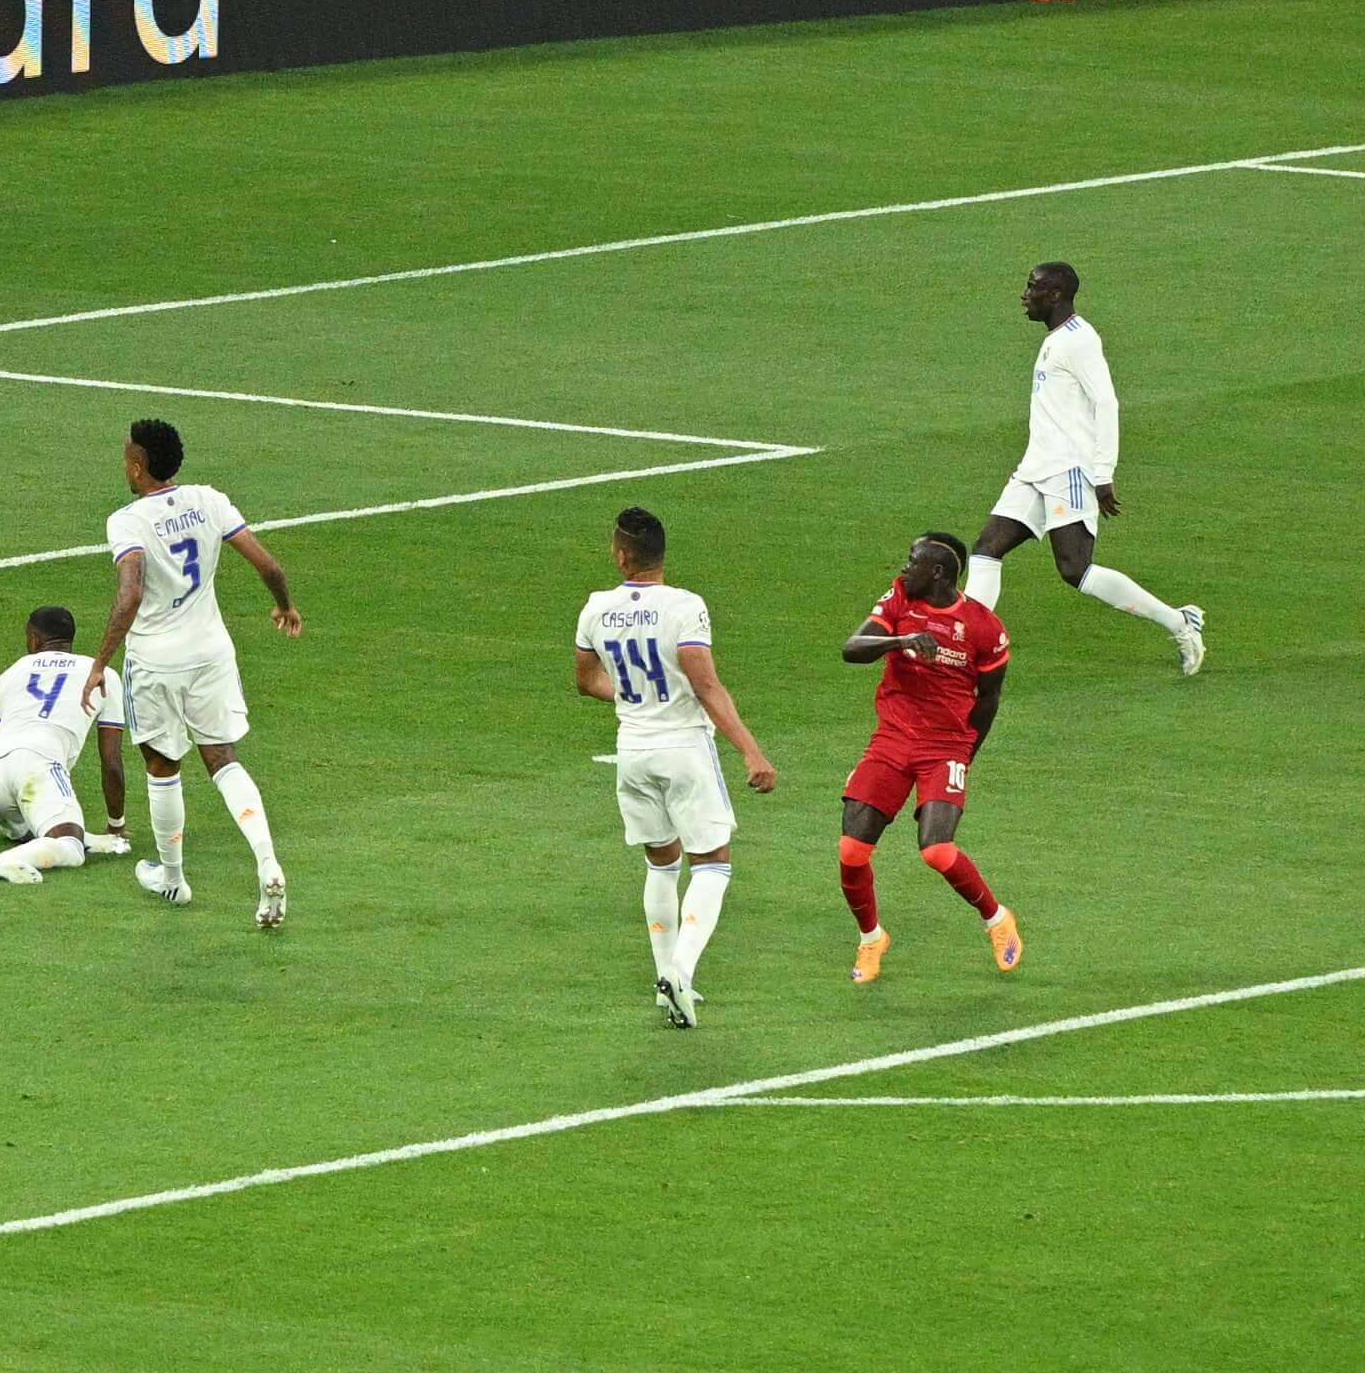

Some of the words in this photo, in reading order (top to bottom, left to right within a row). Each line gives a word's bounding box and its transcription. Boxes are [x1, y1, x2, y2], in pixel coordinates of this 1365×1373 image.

[168, 537, 200, 610] 3
[601, 610, 659, 629] CASEMIRO
[26, 672, 69, 719] 4
[604, 637, 671, 705] 14
